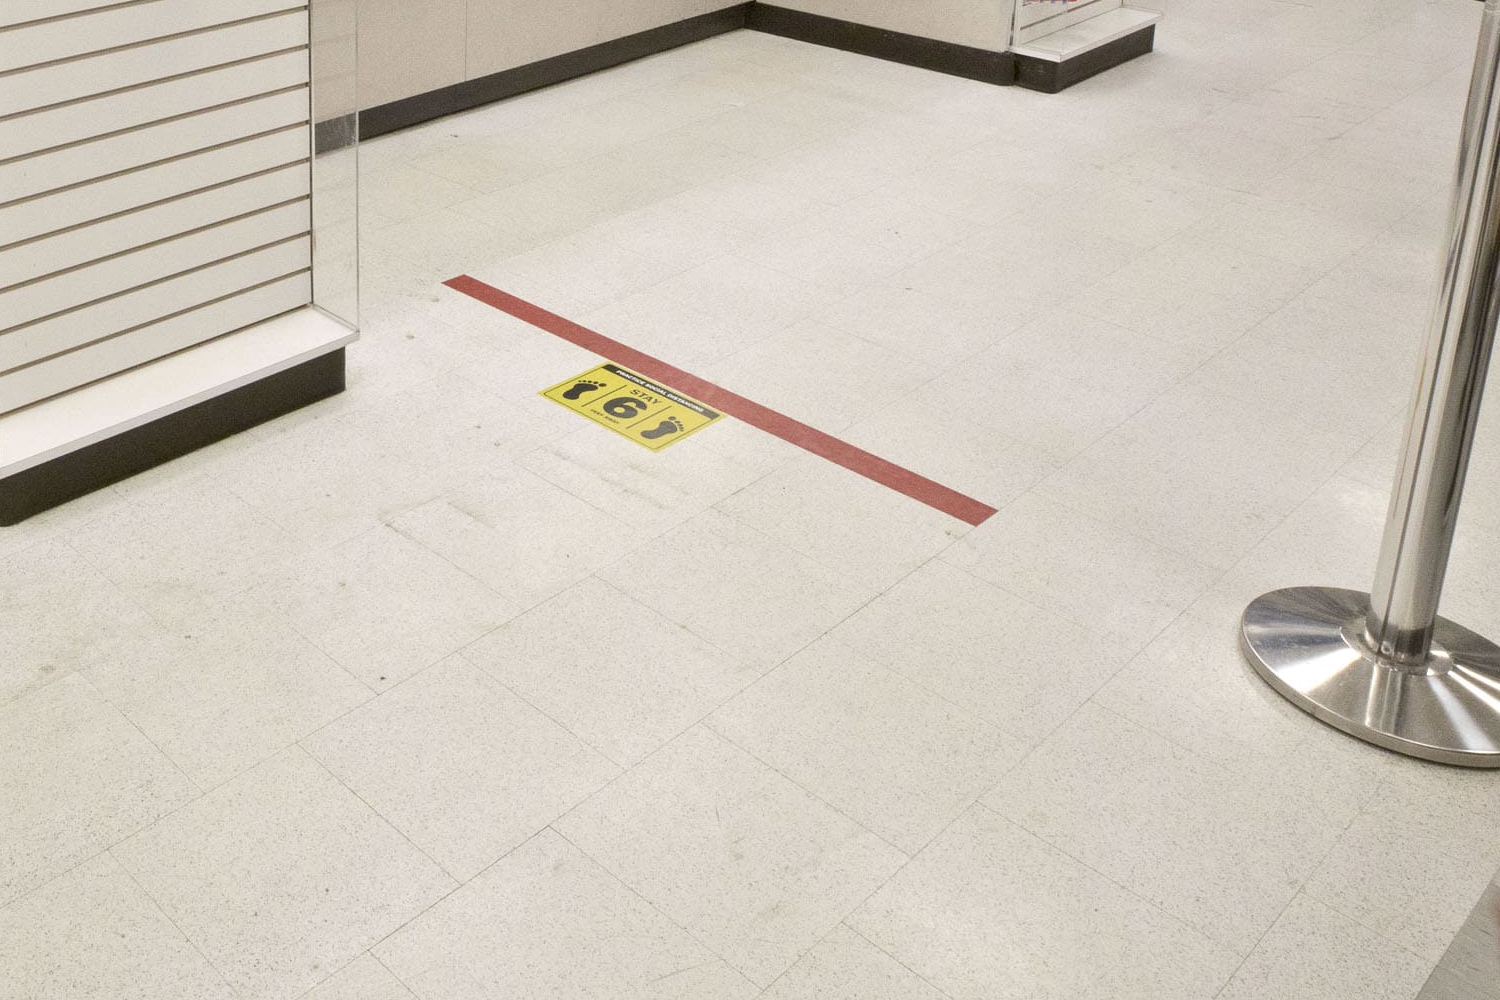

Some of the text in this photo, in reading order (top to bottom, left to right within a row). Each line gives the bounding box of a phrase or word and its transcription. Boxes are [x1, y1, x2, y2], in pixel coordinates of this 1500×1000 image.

[616, 370, 704, 412] PRACTICE SOCIAL DISTANCING
[630, 389, 663, 405] STAY
[603, 397, 647, 418] 6
